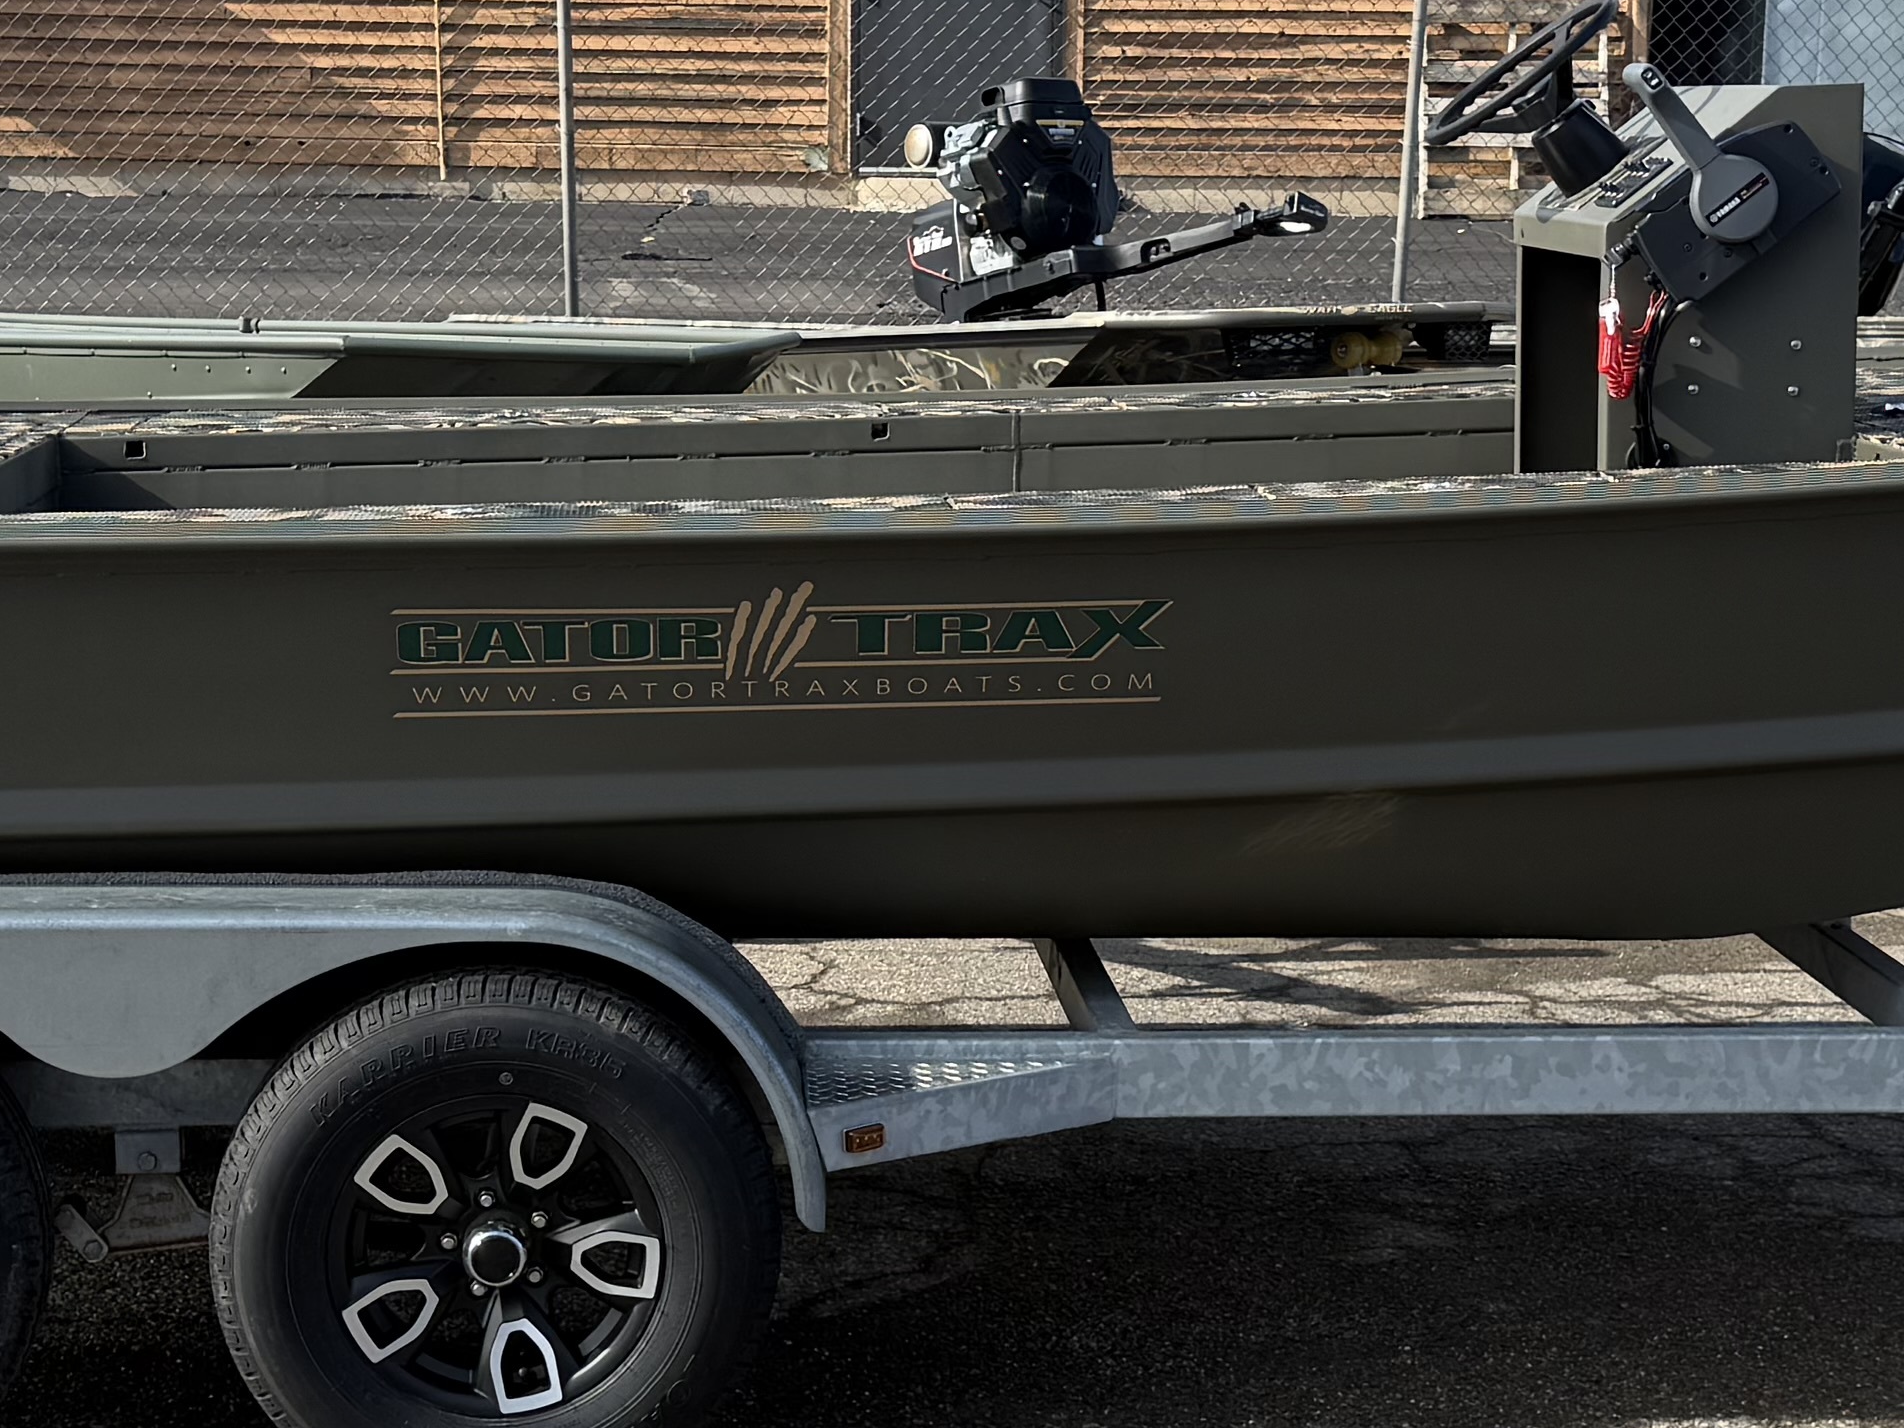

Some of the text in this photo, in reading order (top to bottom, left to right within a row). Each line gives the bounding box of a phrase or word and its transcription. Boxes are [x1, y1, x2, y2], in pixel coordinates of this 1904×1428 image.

[397, 599, 1174, 665] GATOR TRAX
[412, 672, 1153, 705] WWW.GATORTRAXBOATS.COM
[310, 1025, 502, 1130] KARRIER
